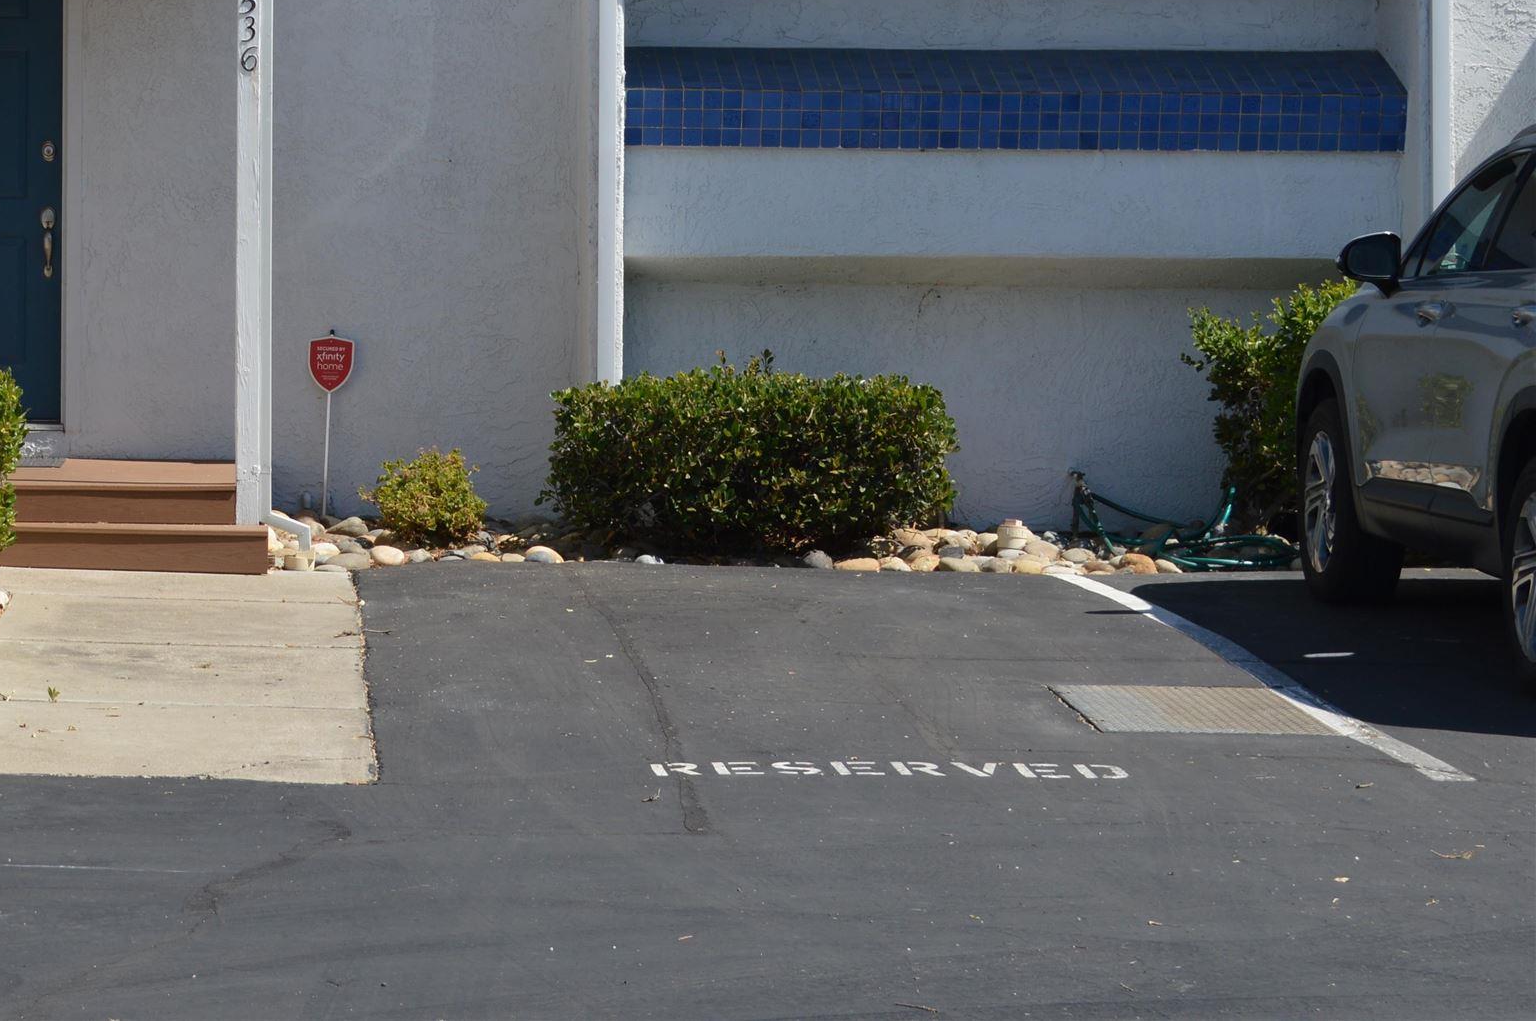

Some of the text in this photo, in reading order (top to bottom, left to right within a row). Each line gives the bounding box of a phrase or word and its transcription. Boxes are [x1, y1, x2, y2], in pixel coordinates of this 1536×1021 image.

[316, 352, 345, 363] xfinity
[316, 362, 344, 370] home
[649, 760, 1130, 780] RESERVED
